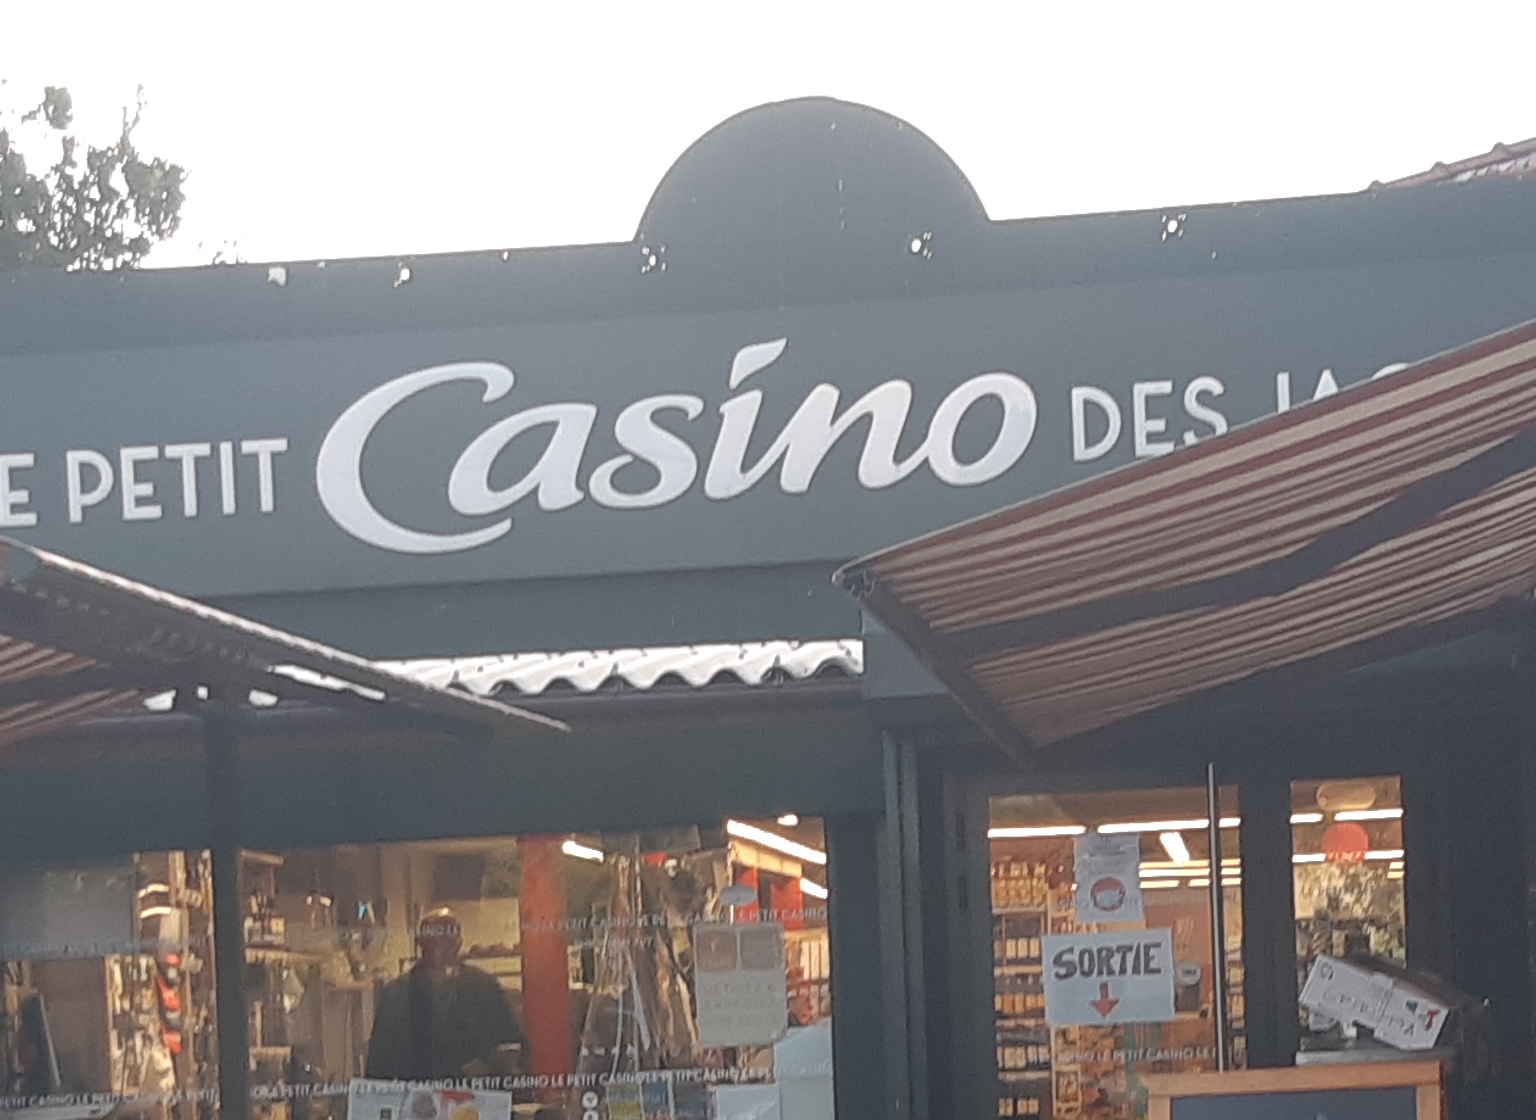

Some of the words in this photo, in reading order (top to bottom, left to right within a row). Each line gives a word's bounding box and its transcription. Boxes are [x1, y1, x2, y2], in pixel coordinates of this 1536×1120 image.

[67, 437, 289, 525] PETIT
[315, 337, 1037, 554] Casino
[1070, 375, 1229, 463] DES
[1052, 940, 1164, 981] SORTIE
[472, 1075, 501, 1091] PETIT
[502, 1073, 549, 1089] CASINO
[551, 1073, 566, 1088] LE
[567, 1071, 597, 1088] PETIT
